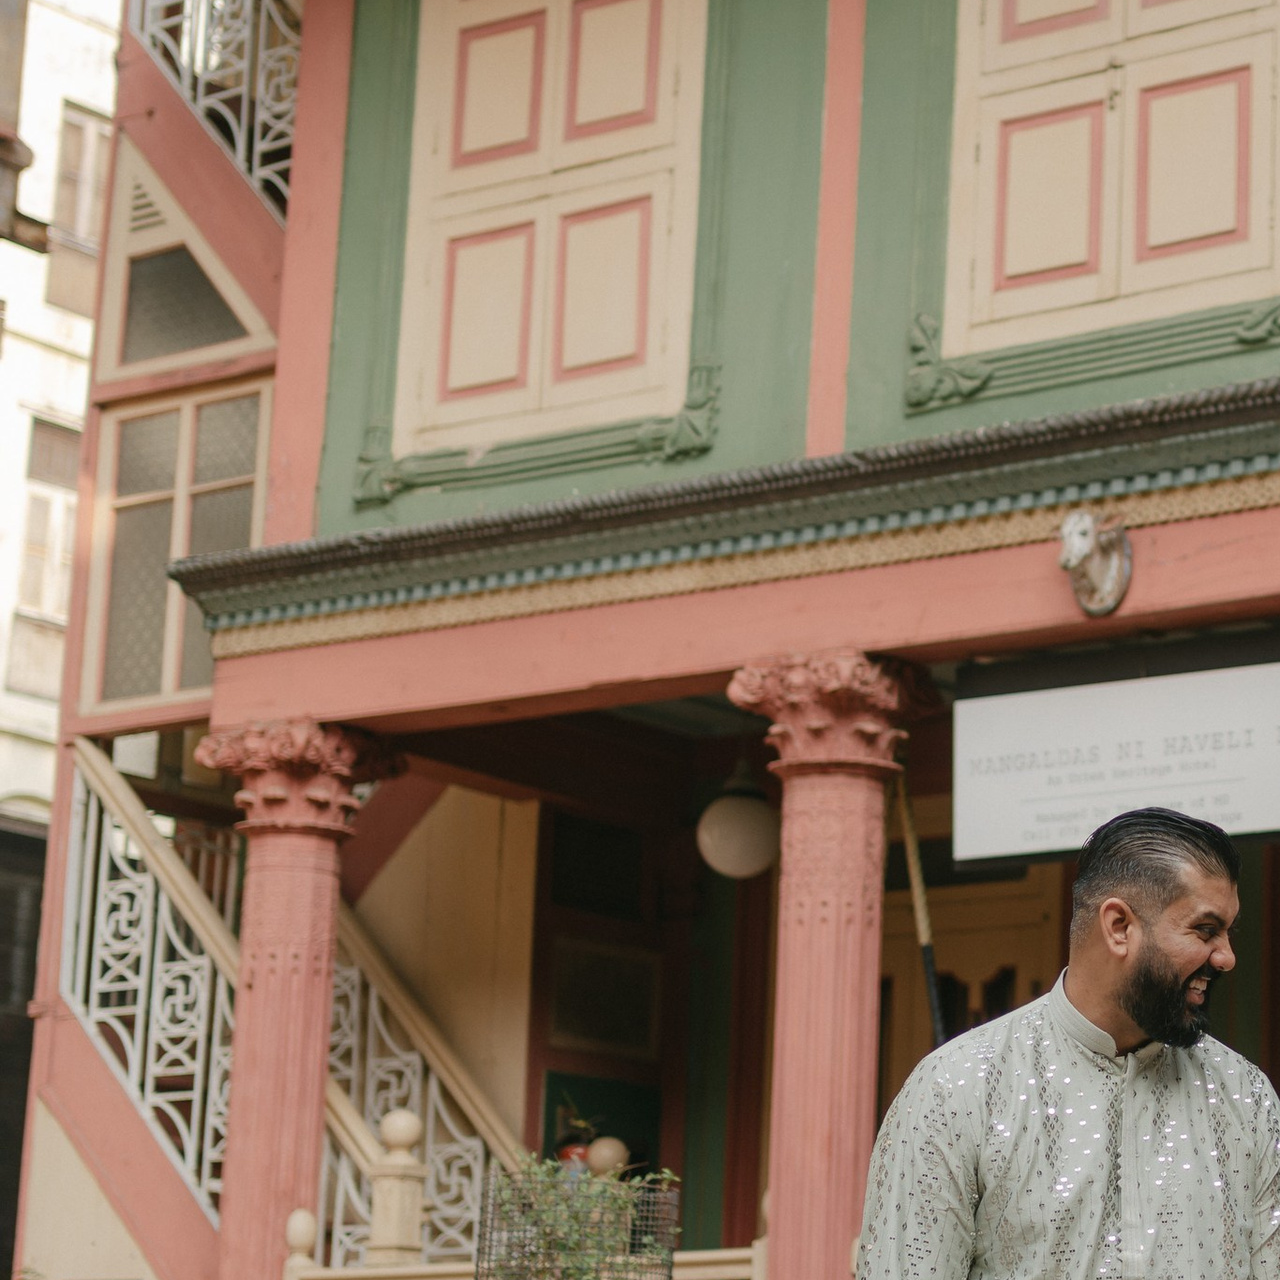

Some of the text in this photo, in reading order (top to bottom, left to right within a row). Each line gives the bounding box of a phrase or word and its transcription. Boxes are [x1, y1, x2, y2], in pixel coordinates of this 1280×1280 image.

[968, 744, 1100, 776] MANGALDAS
[1117, 740, 1145, 762] NI
[1163, 728, 1254, 757] HAVELI
